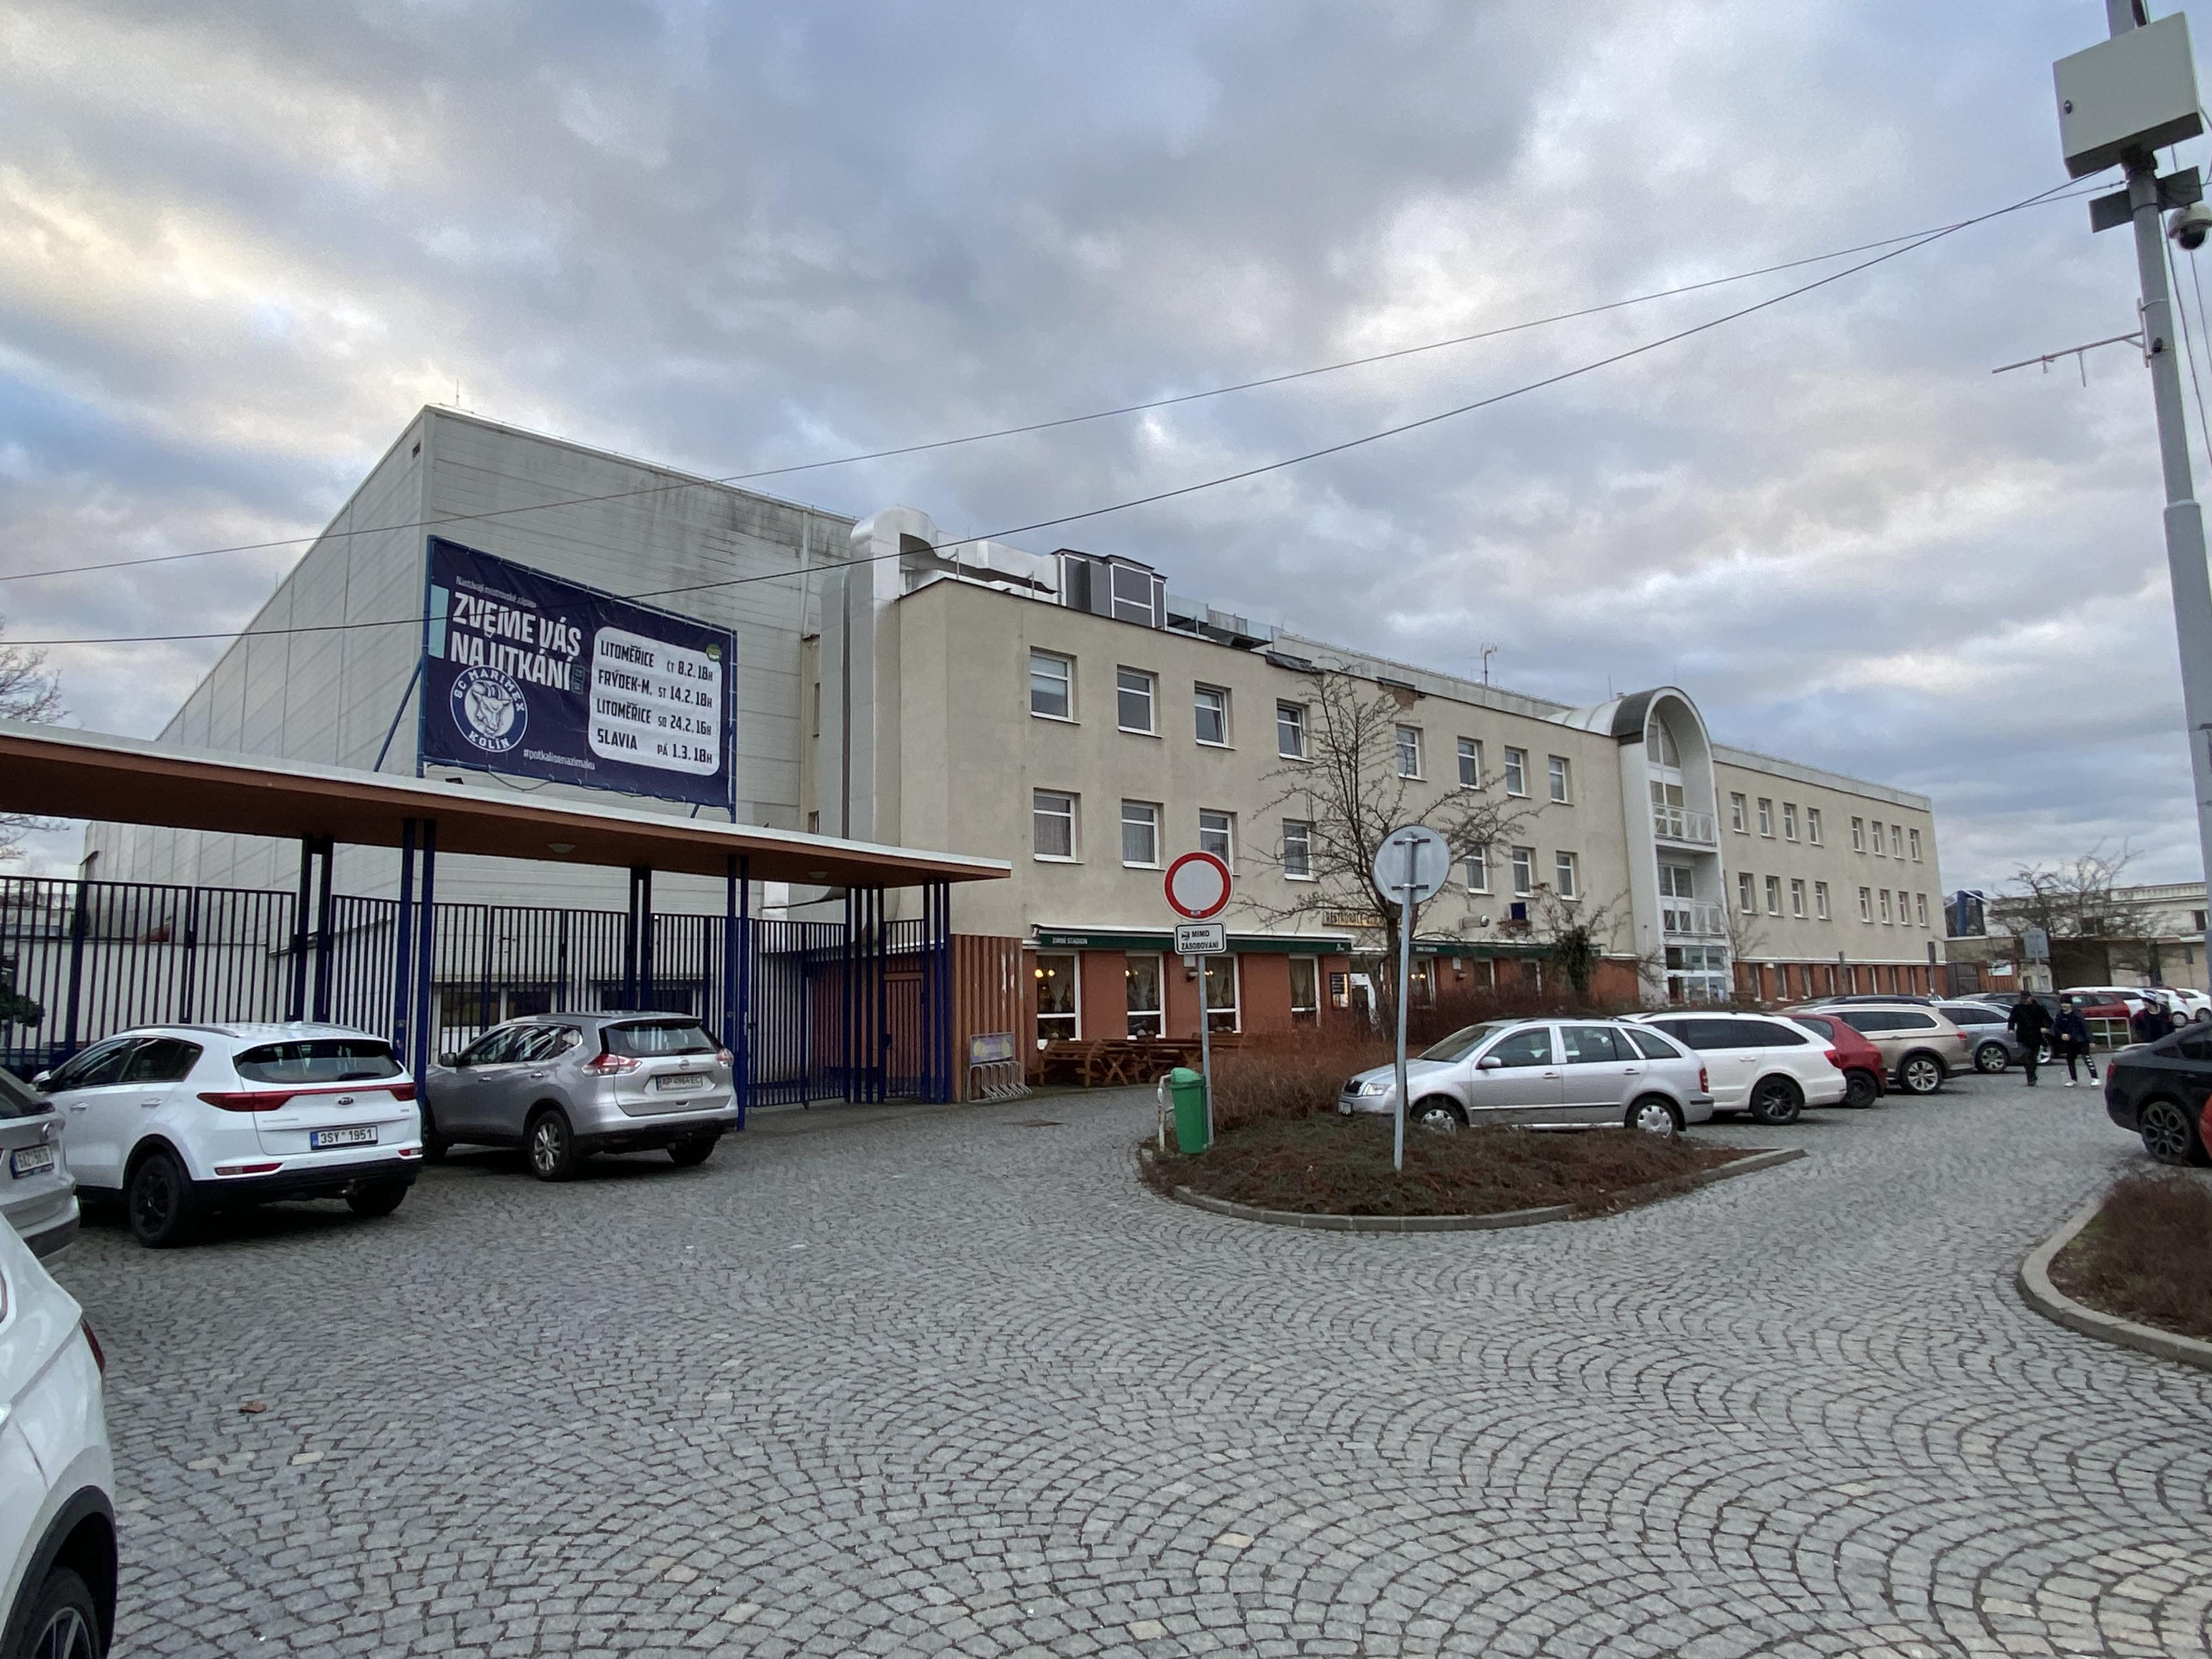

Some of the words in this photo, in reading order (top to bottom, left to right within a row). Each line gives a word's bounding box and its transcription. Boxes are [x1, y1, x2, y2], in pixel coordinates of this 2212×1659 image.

[539, 617, 581, 656] VÁS
[450, 631, 484, 666] NA
[489, 641, 574, 691] UTKÁNÍ
[601, 640, 654, 668] LITOMĚŘICE
[666, 659, 675, 673] ČT
[453, 680, 467, 698] SC
[468, 668, 525, 712] MARIMEX
[598, 669, 653, 696] FRÝDEK-M.
[658, 687, 666, 698] ST
[597, 698, 652, 724] LITOMĚŘICE
[658, 716, 667, 728] SO
[469, 730, 510, 749] KOLÍN
[597, 728, 638, 750] SLAVIA
[657, 743, 668, 757] PÁ
[320, 1131, 340, 1144] 3SY
[349, 1128, 372, 1141] 1951
